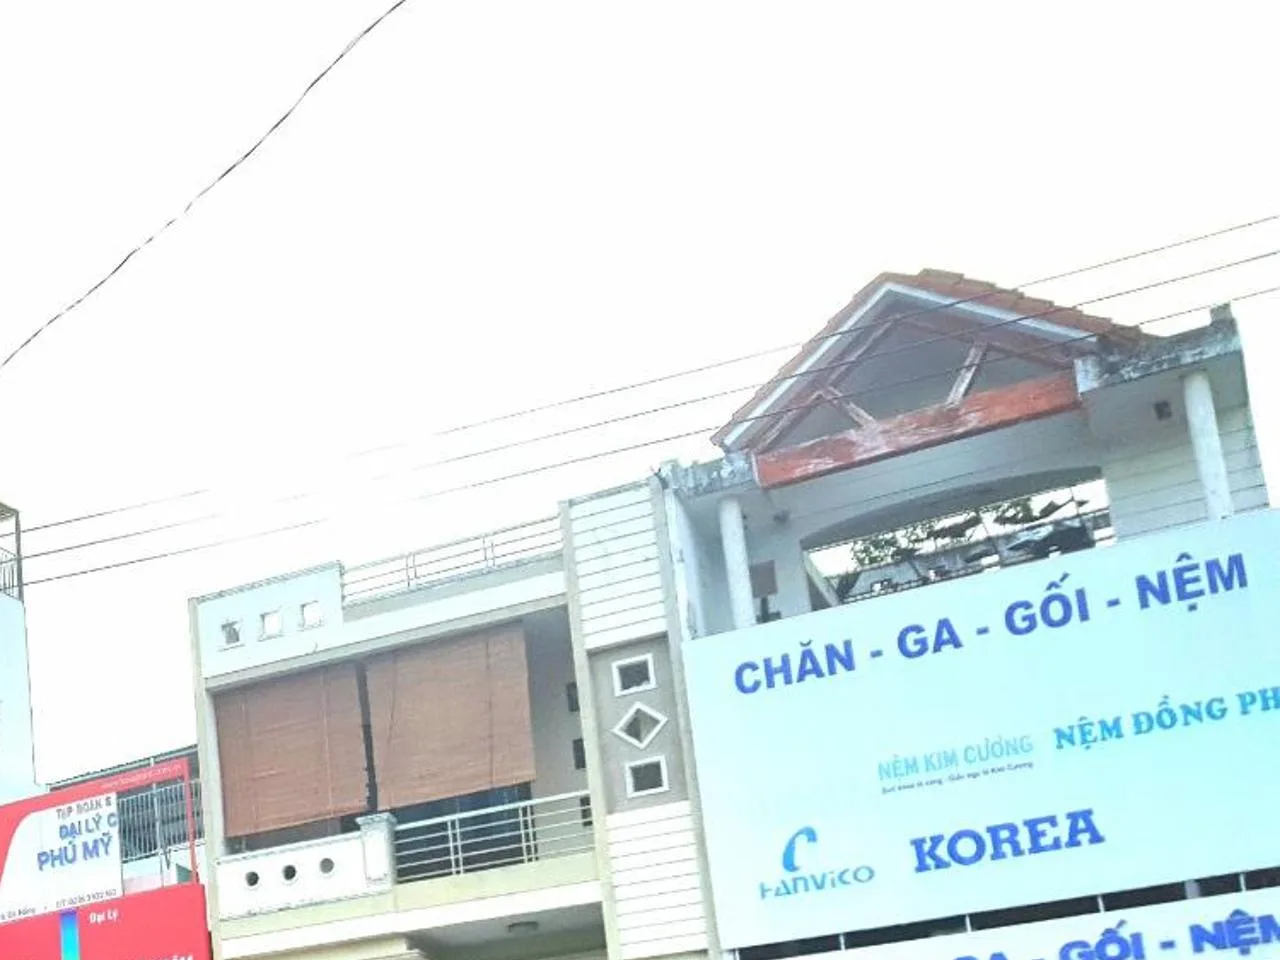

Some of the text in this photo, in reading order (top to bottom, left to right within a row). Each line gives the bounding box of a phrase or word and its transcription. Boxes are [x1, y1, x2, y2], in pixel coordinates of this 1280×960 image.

[734, 638, 856, 695] CHĂN
[896, 616, 963, 659] GA
[1003, 571, 1091, 637] GỐI
[1135, 551, 1248, 612] NỆM
[1052, 715, 1125, 750] NỆM
[1131, 693, 1229, 736] ĐỒNG
[922, 748, 959, 773] KIM
[84, 812, 103, 833] LÝ
[910, 808, 1106, 874] KOREA
[37, 830, 113, 872] PHÚ MỸ
